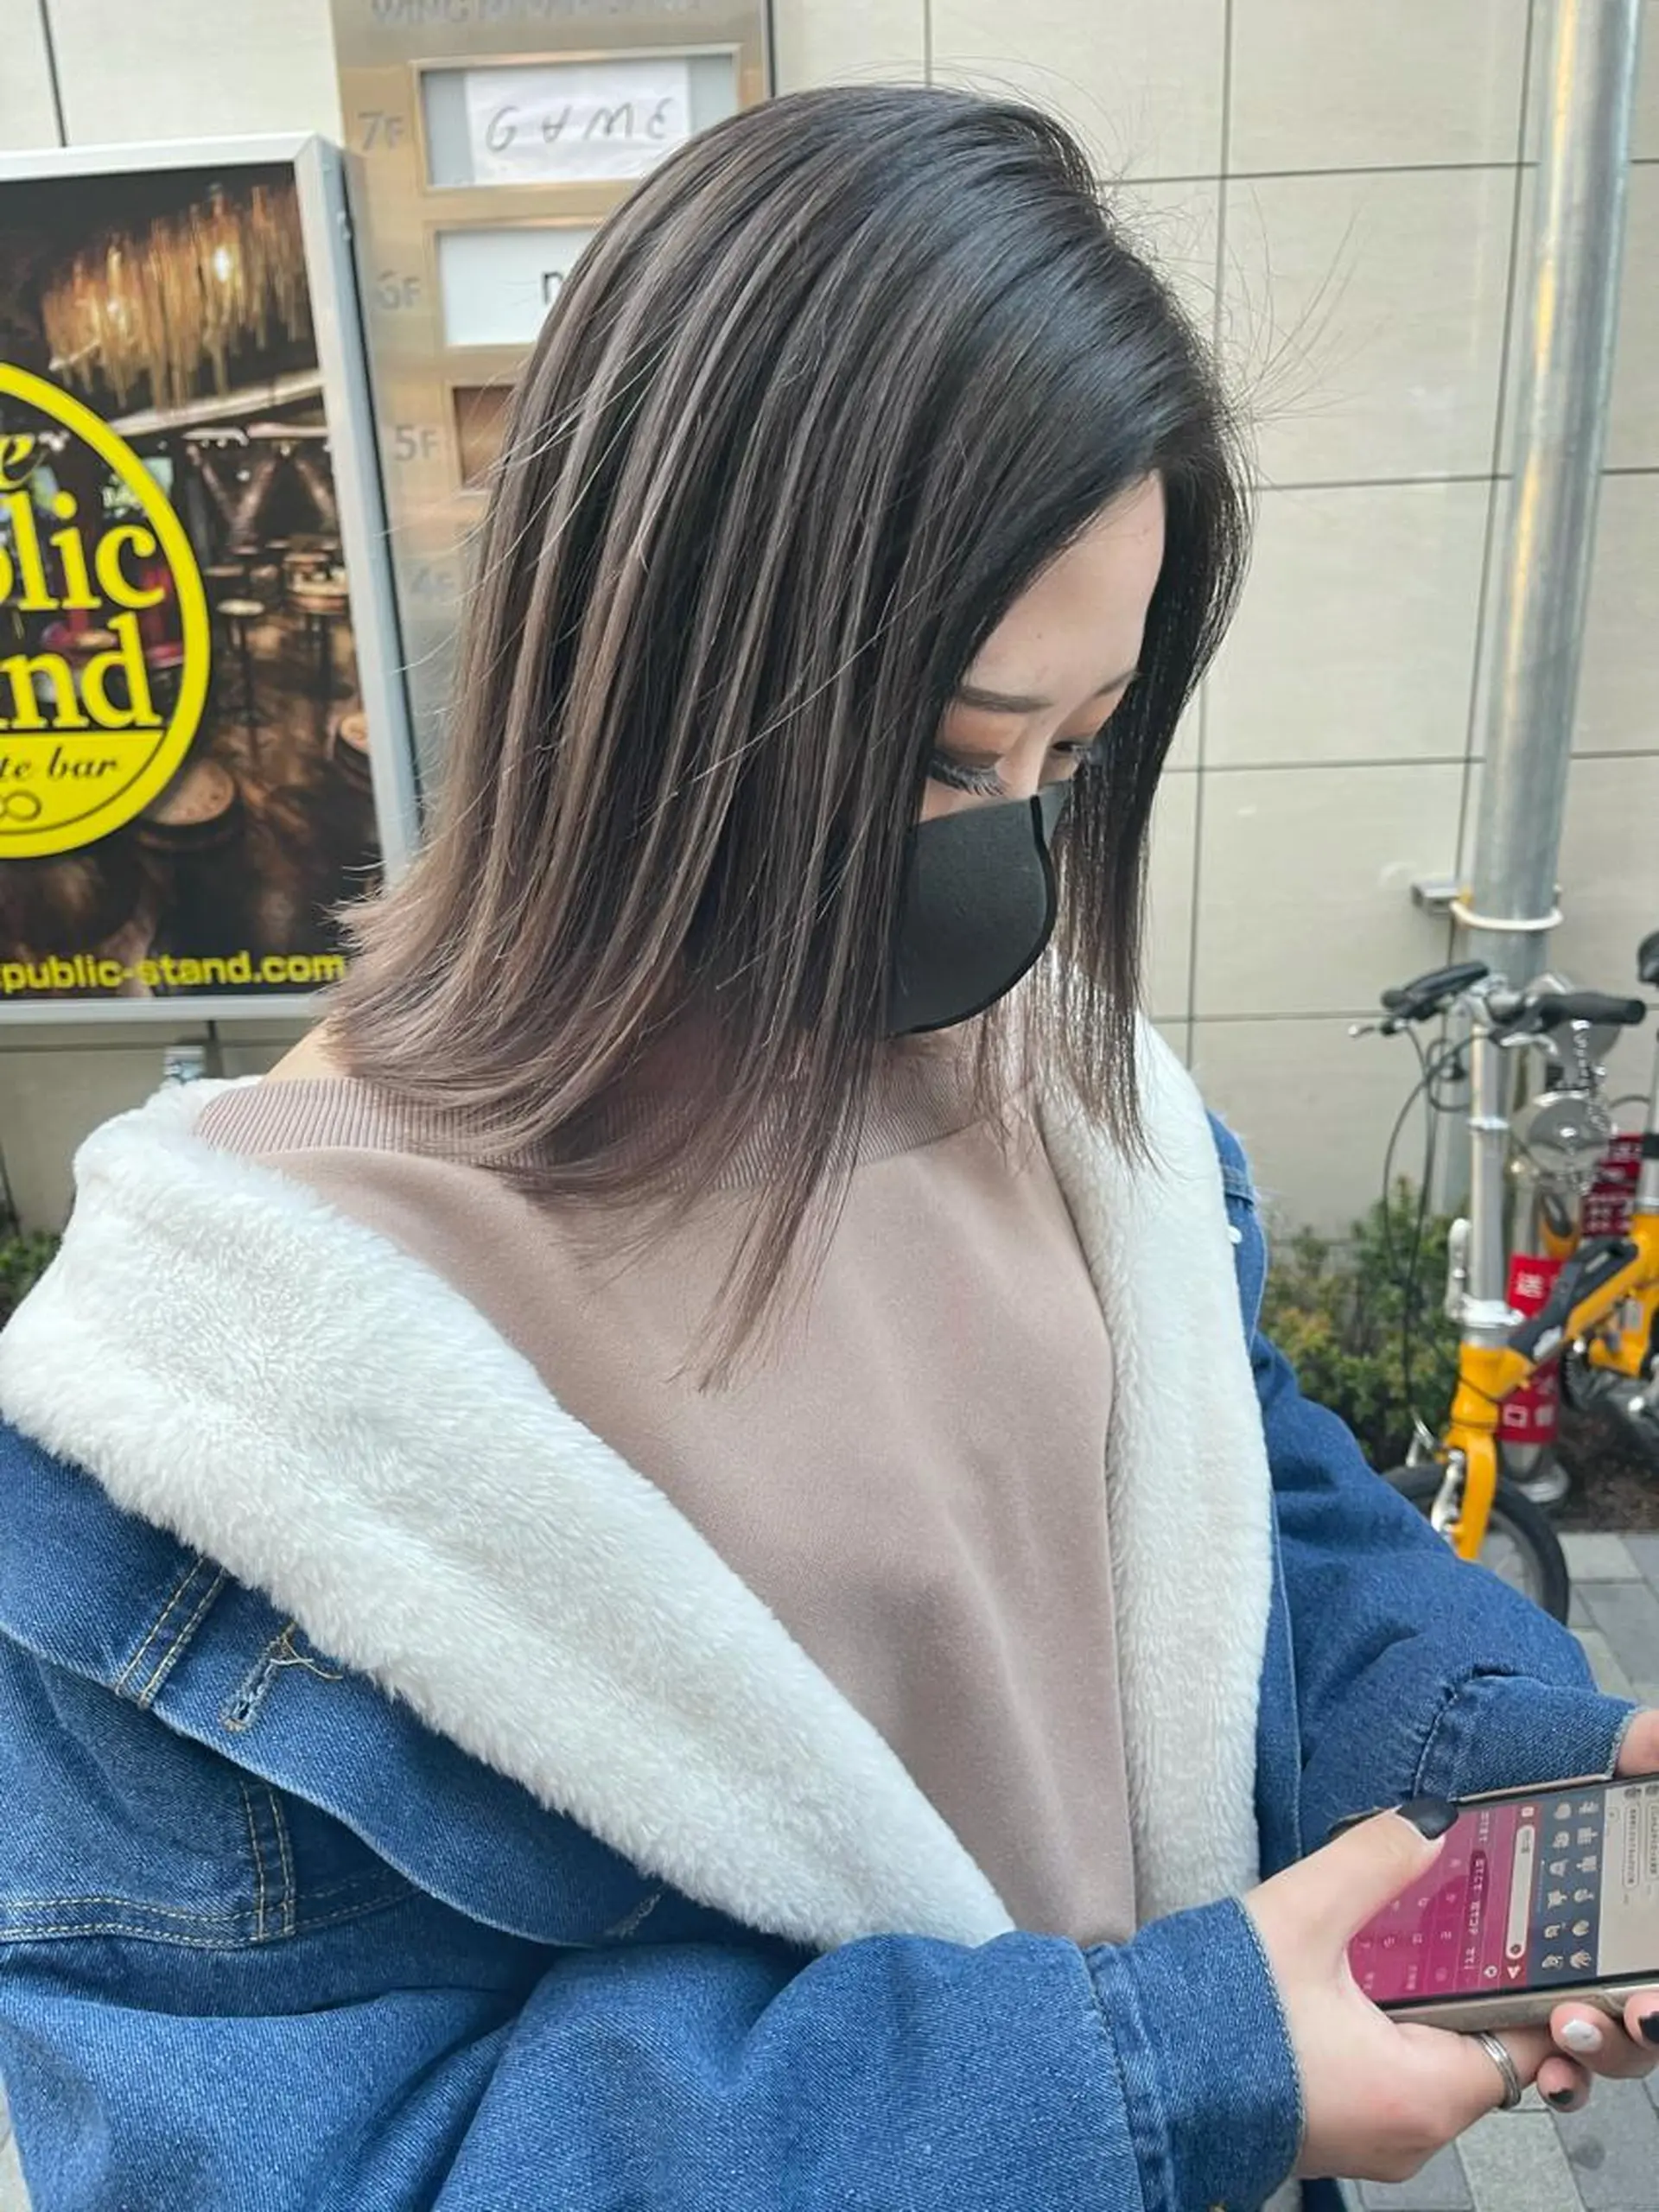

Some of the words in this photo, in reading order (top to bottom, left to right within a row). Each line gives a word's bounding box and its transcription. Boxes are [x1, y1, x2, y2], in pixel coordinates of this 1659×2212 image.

[358, 110, 405, 152] 7F
[394, 424, 438, 462] 5F
[0, 611, 162, 729] nd
[48, 744, 117, 779] bar
[2, 951, 345, 995] public-stand.com
